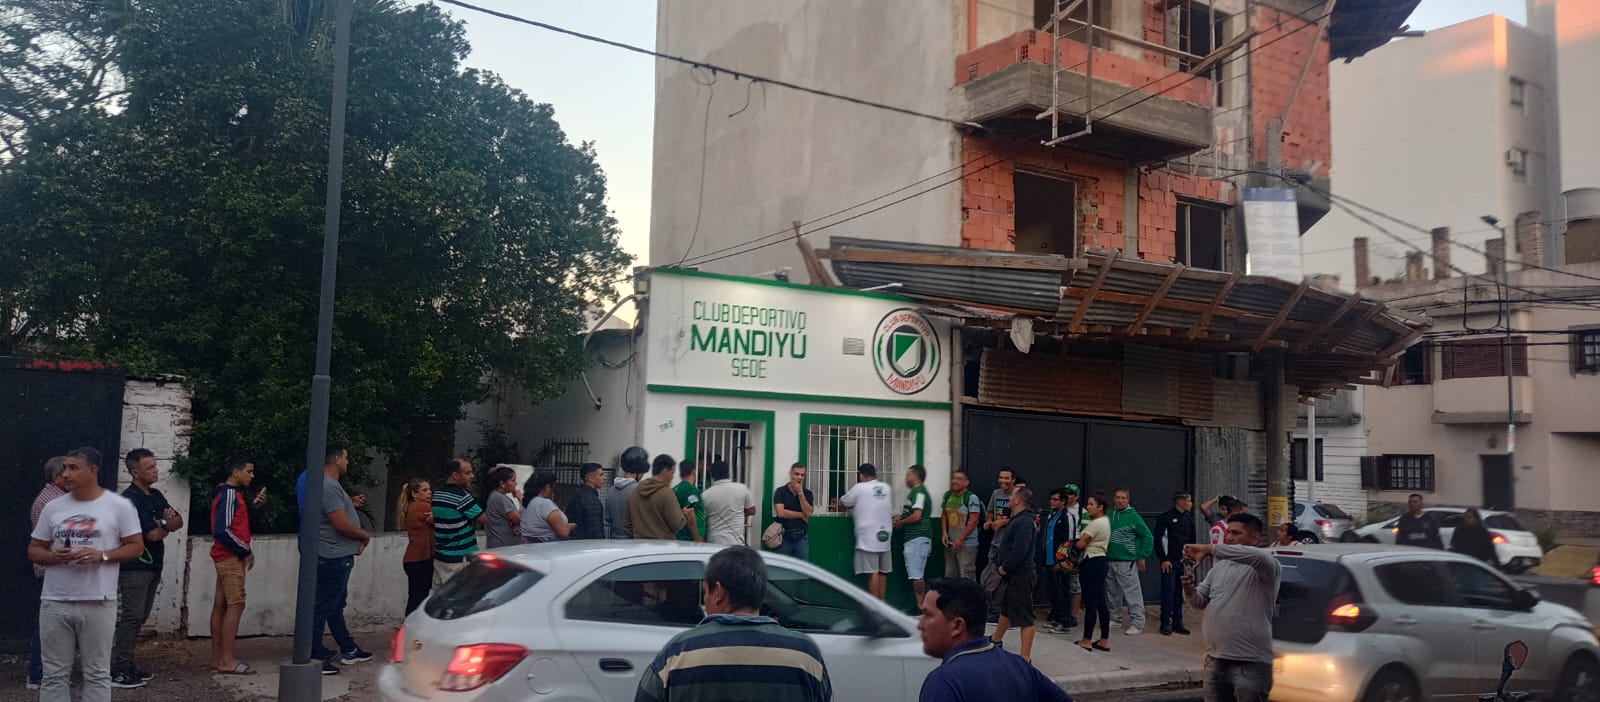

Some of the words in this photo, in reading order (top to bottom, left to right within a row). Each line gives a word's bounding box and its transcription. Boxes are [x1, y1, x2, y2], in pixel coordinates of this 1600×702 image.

[693, 300, 730, 323] CLUB
[732, 305, 807, 330] DEPORTIVO
[884, 315, 899, 333] CLUB
[900, 313, 930, 337] DEPORTIVO
[690, 324, 807, 359] MANDIYÚ
[731, 357, 767, 379] SEDE
